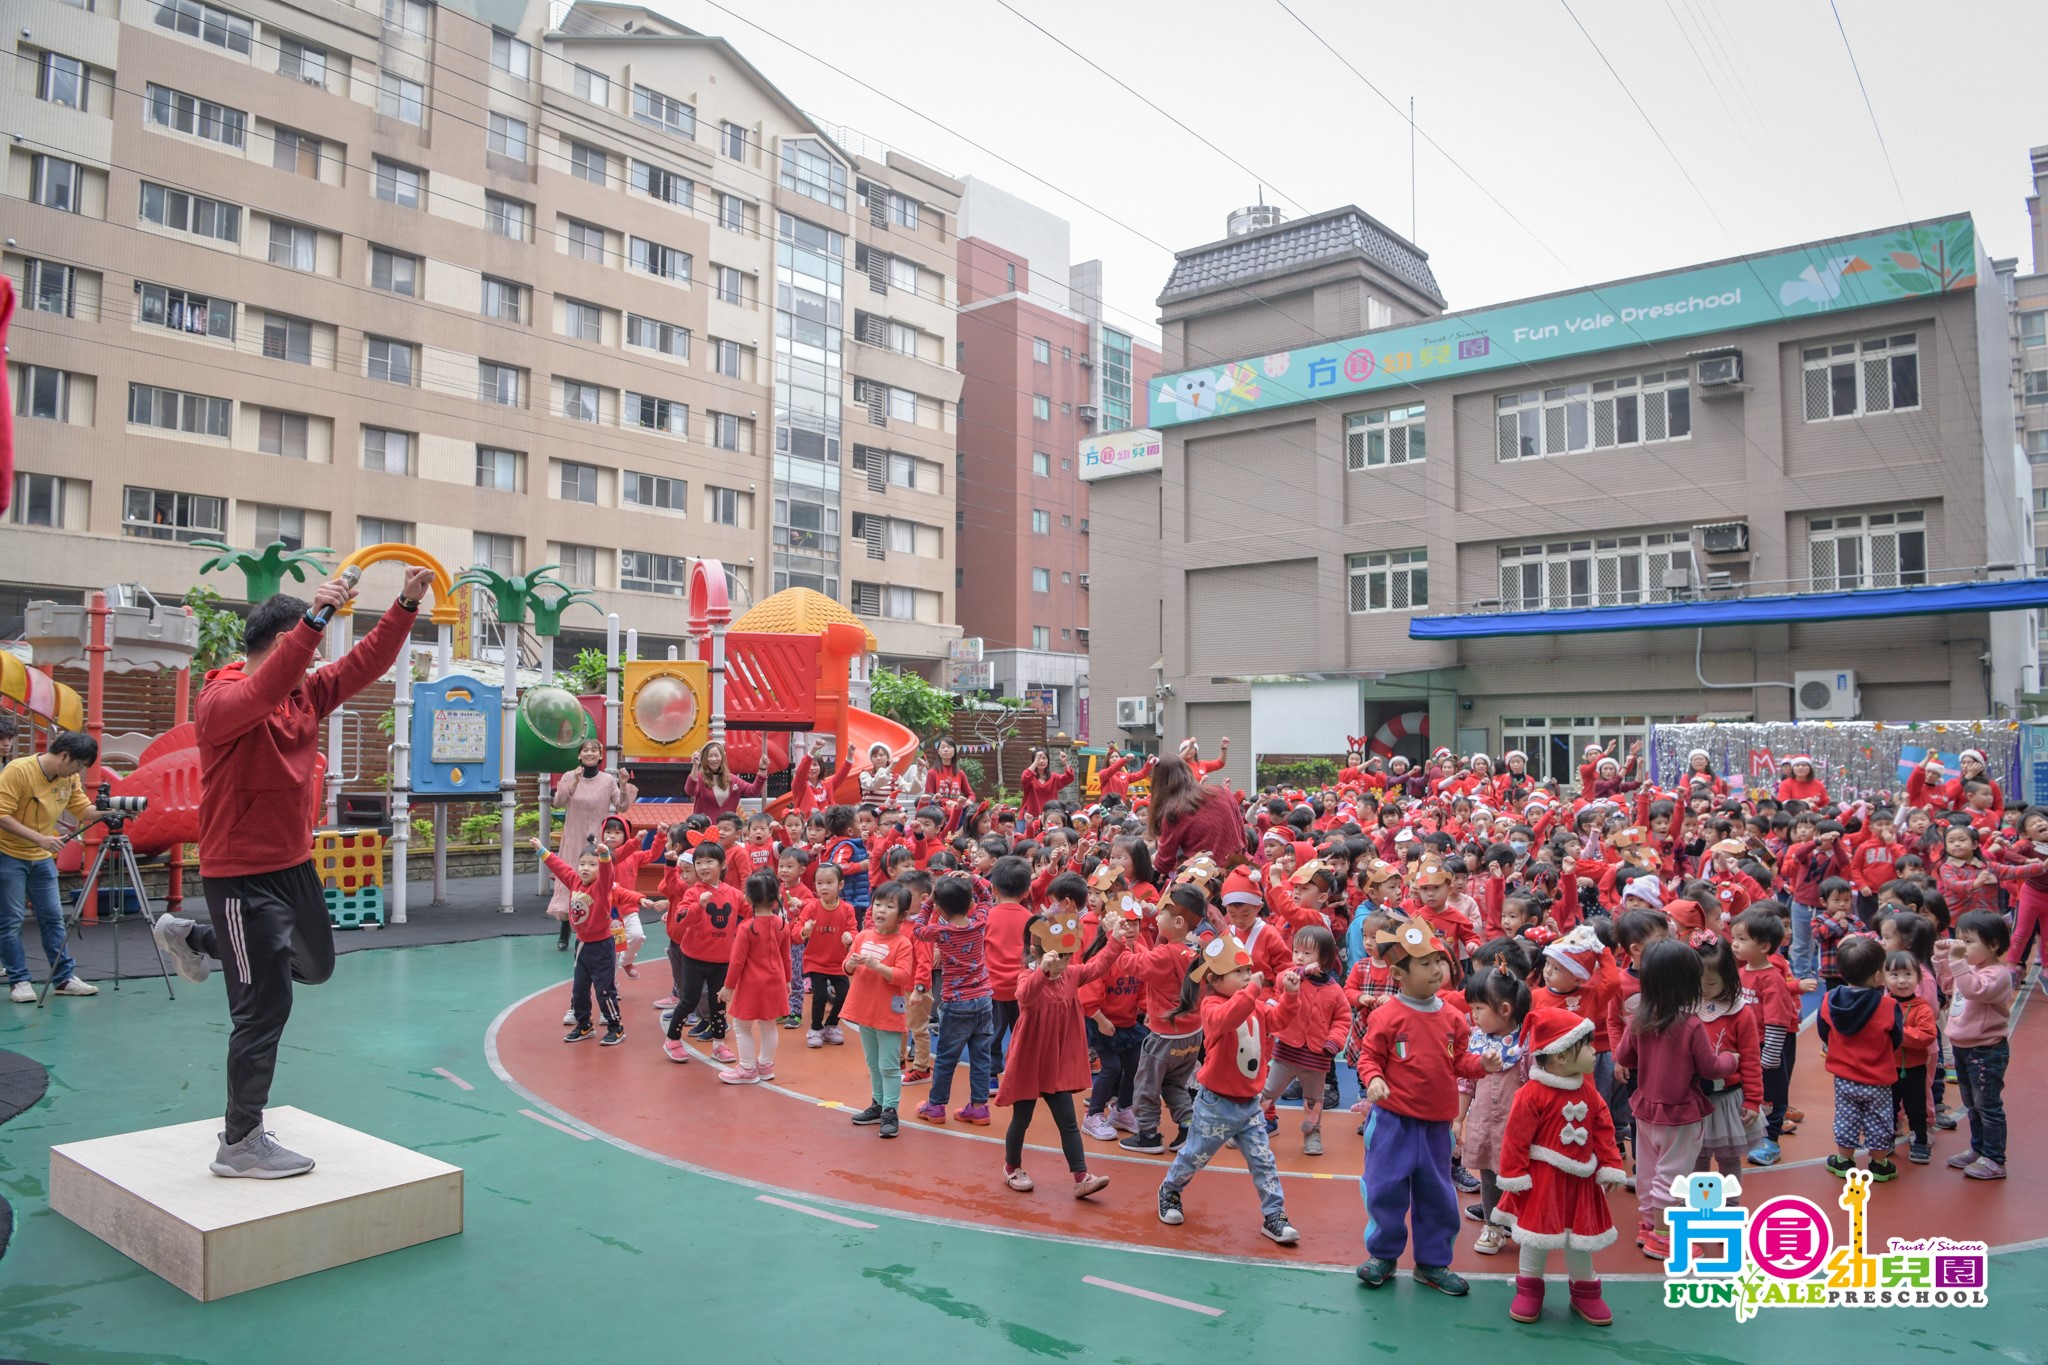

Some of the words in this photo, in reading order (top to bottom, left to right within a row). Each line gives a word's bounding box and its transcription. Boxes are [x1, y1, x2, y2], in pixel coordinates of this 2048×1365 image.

[1512, 324, 1560, 345] Fun
[1565, 313, 1615, 334] Yale
[1621, 287, 1742, 325] Preschool
